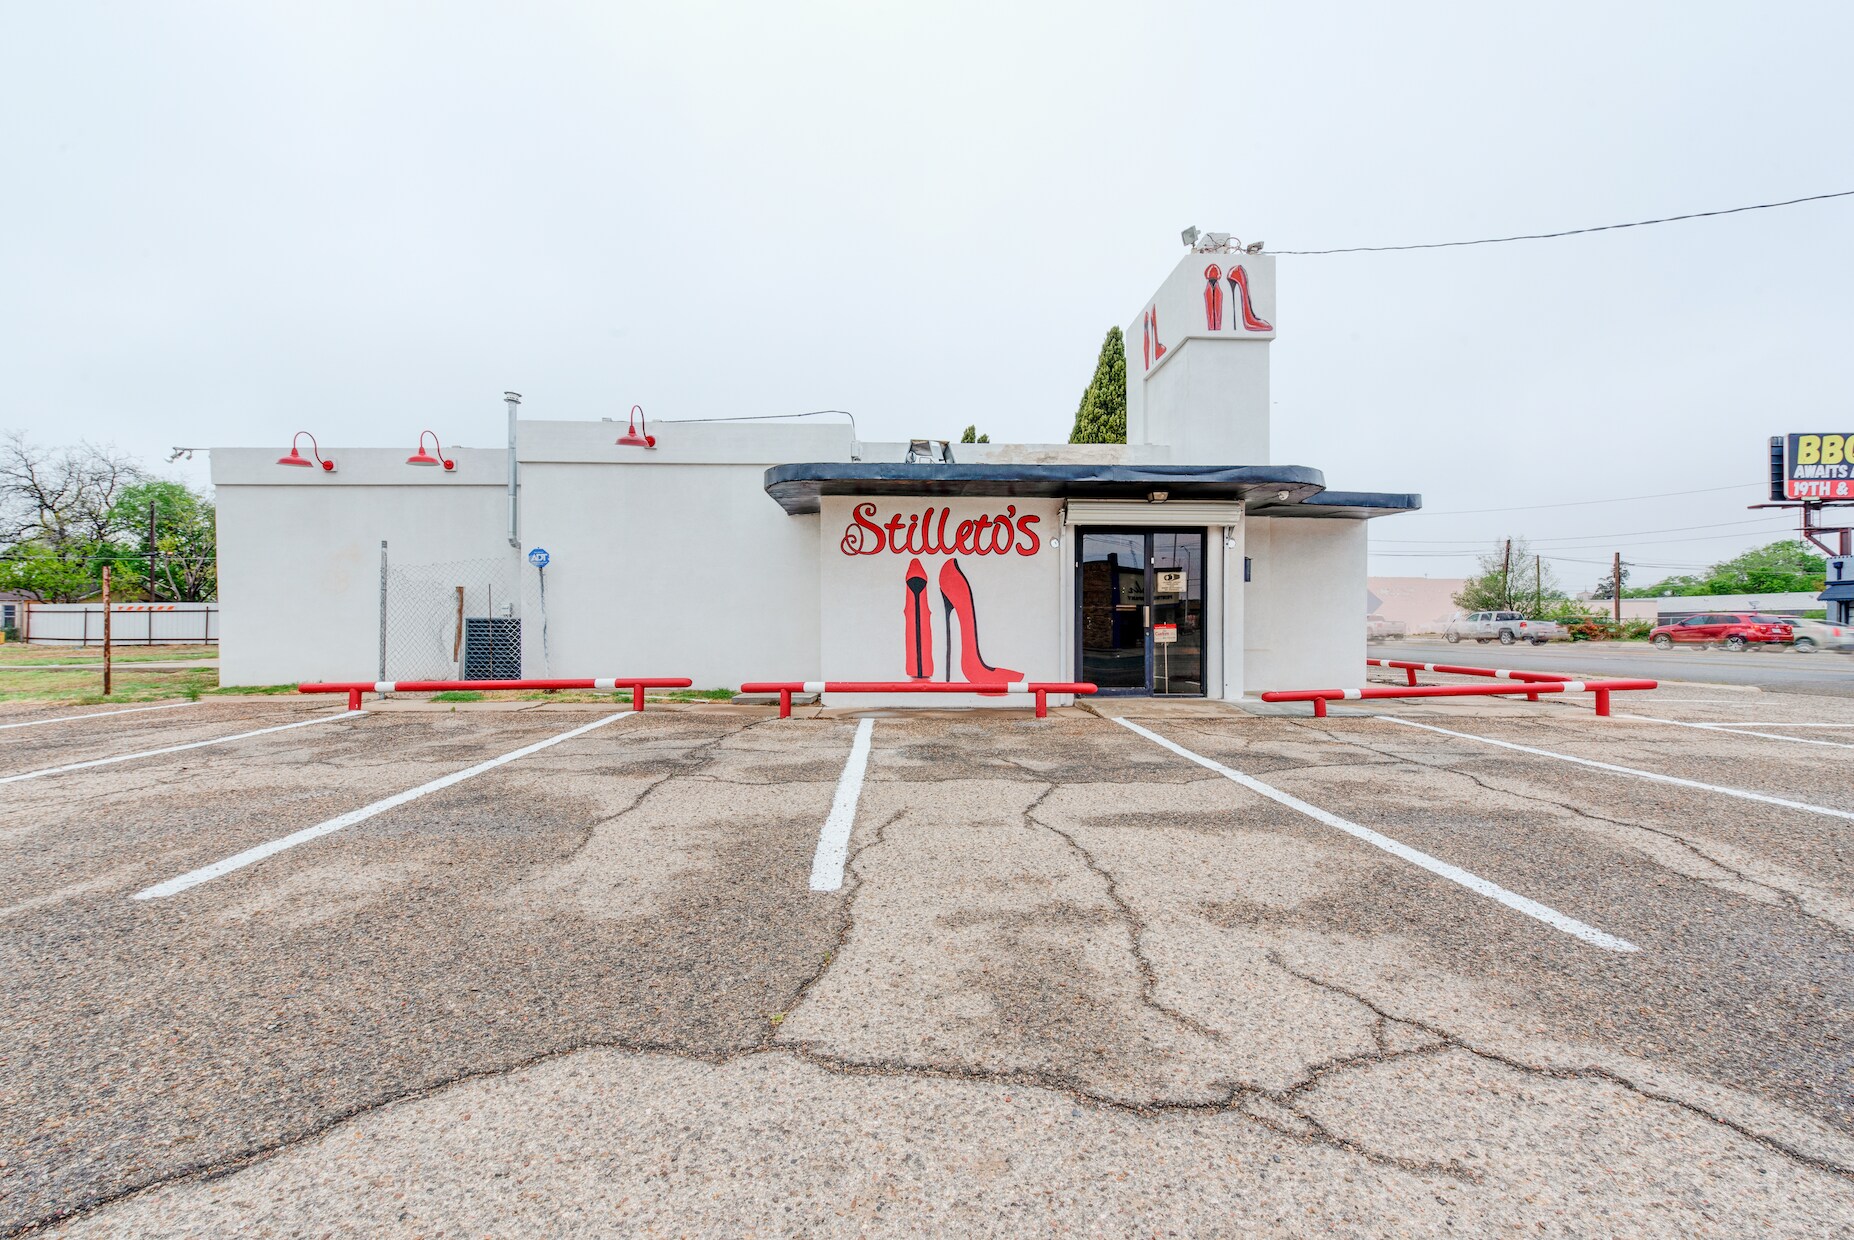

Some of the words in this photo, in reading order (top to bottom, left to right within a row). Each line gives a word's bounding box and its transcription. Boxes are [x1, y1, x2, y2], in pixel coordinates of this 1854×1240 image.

[1793, 465, 1848, 478] AWAITS
[1793, 481, 1831, 496] 19TH
[1836, 481, 1849, 496] &
[840, 502, 1041, 556] Stilleto's
[531, 553, 548, 561] ADT
